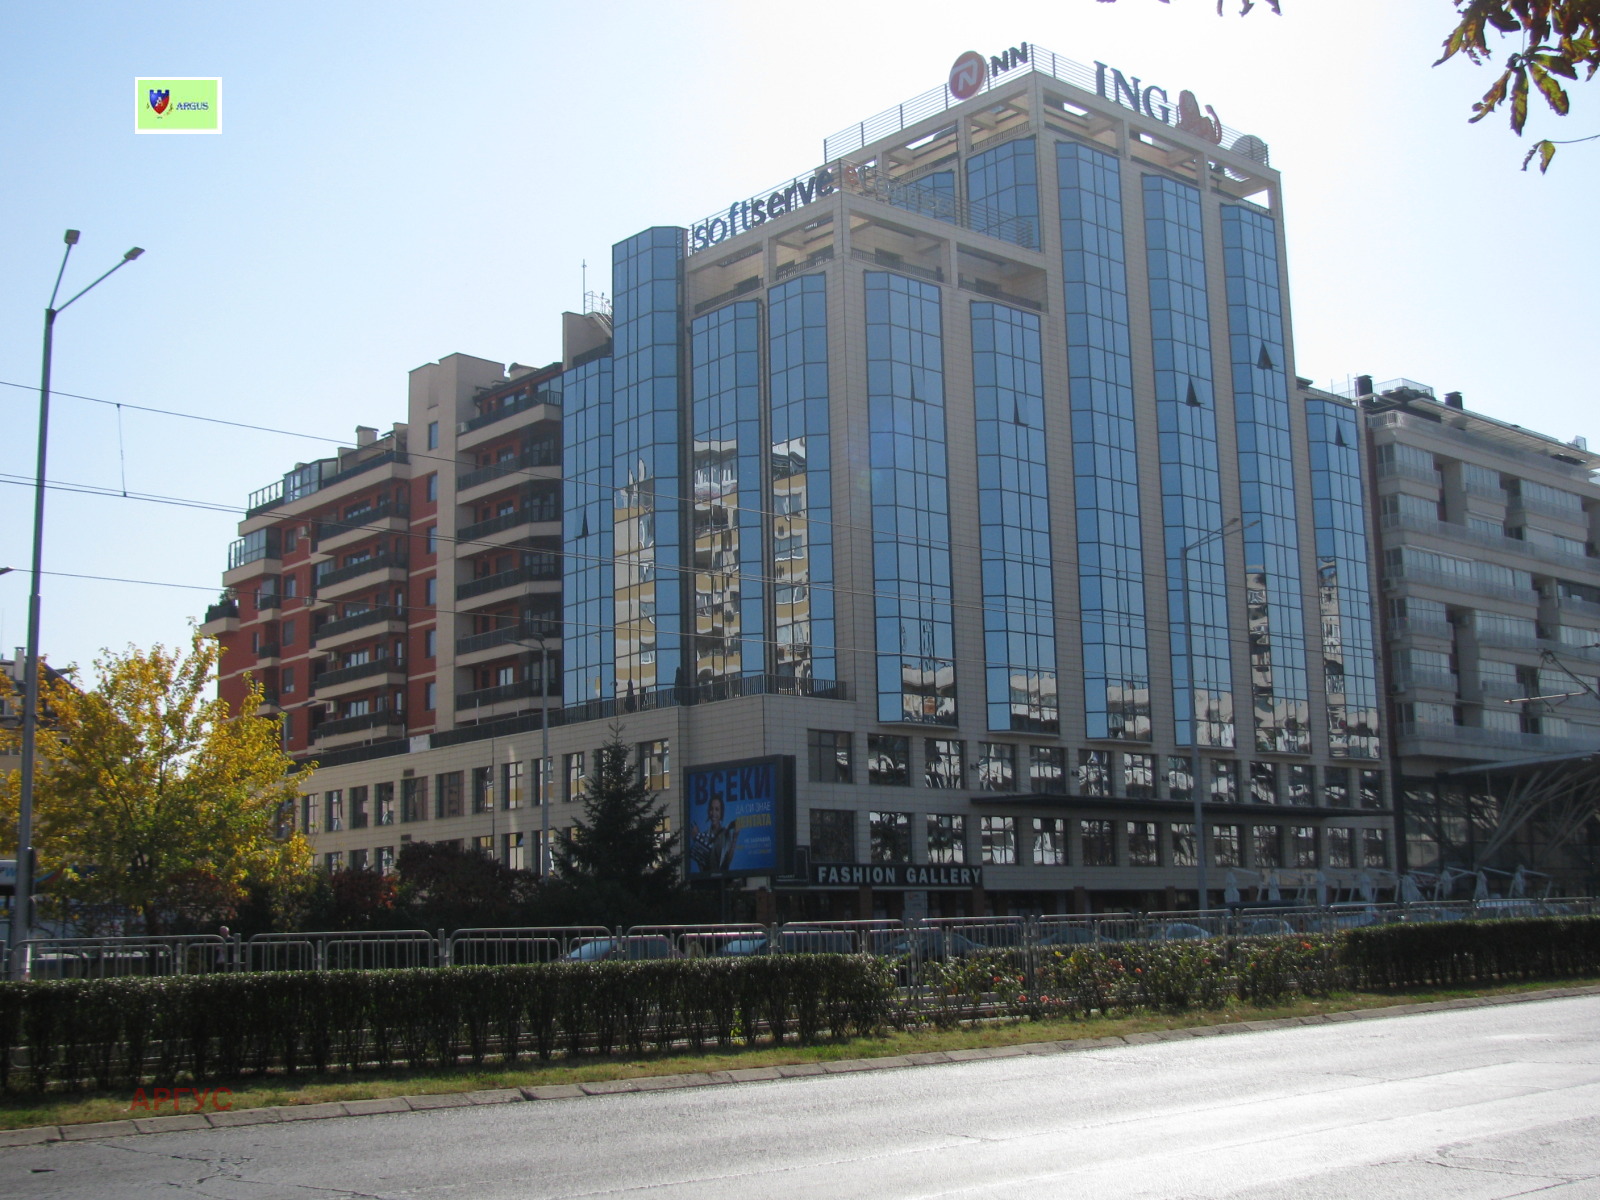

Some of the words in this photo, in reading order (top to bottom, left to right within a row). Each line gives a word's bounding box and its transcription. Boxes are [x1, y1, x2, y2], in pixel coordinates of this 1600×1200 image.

[990, 41, 1028, 77] NN
[1093, 60, 1170, 124] ING
[694, 168, 834, 251] softserve
[695, 764, 771, 806] ВСЕКИ
[818, 866, 896, 884] FASHION
[906, 866, 981, 884] GALLERY
